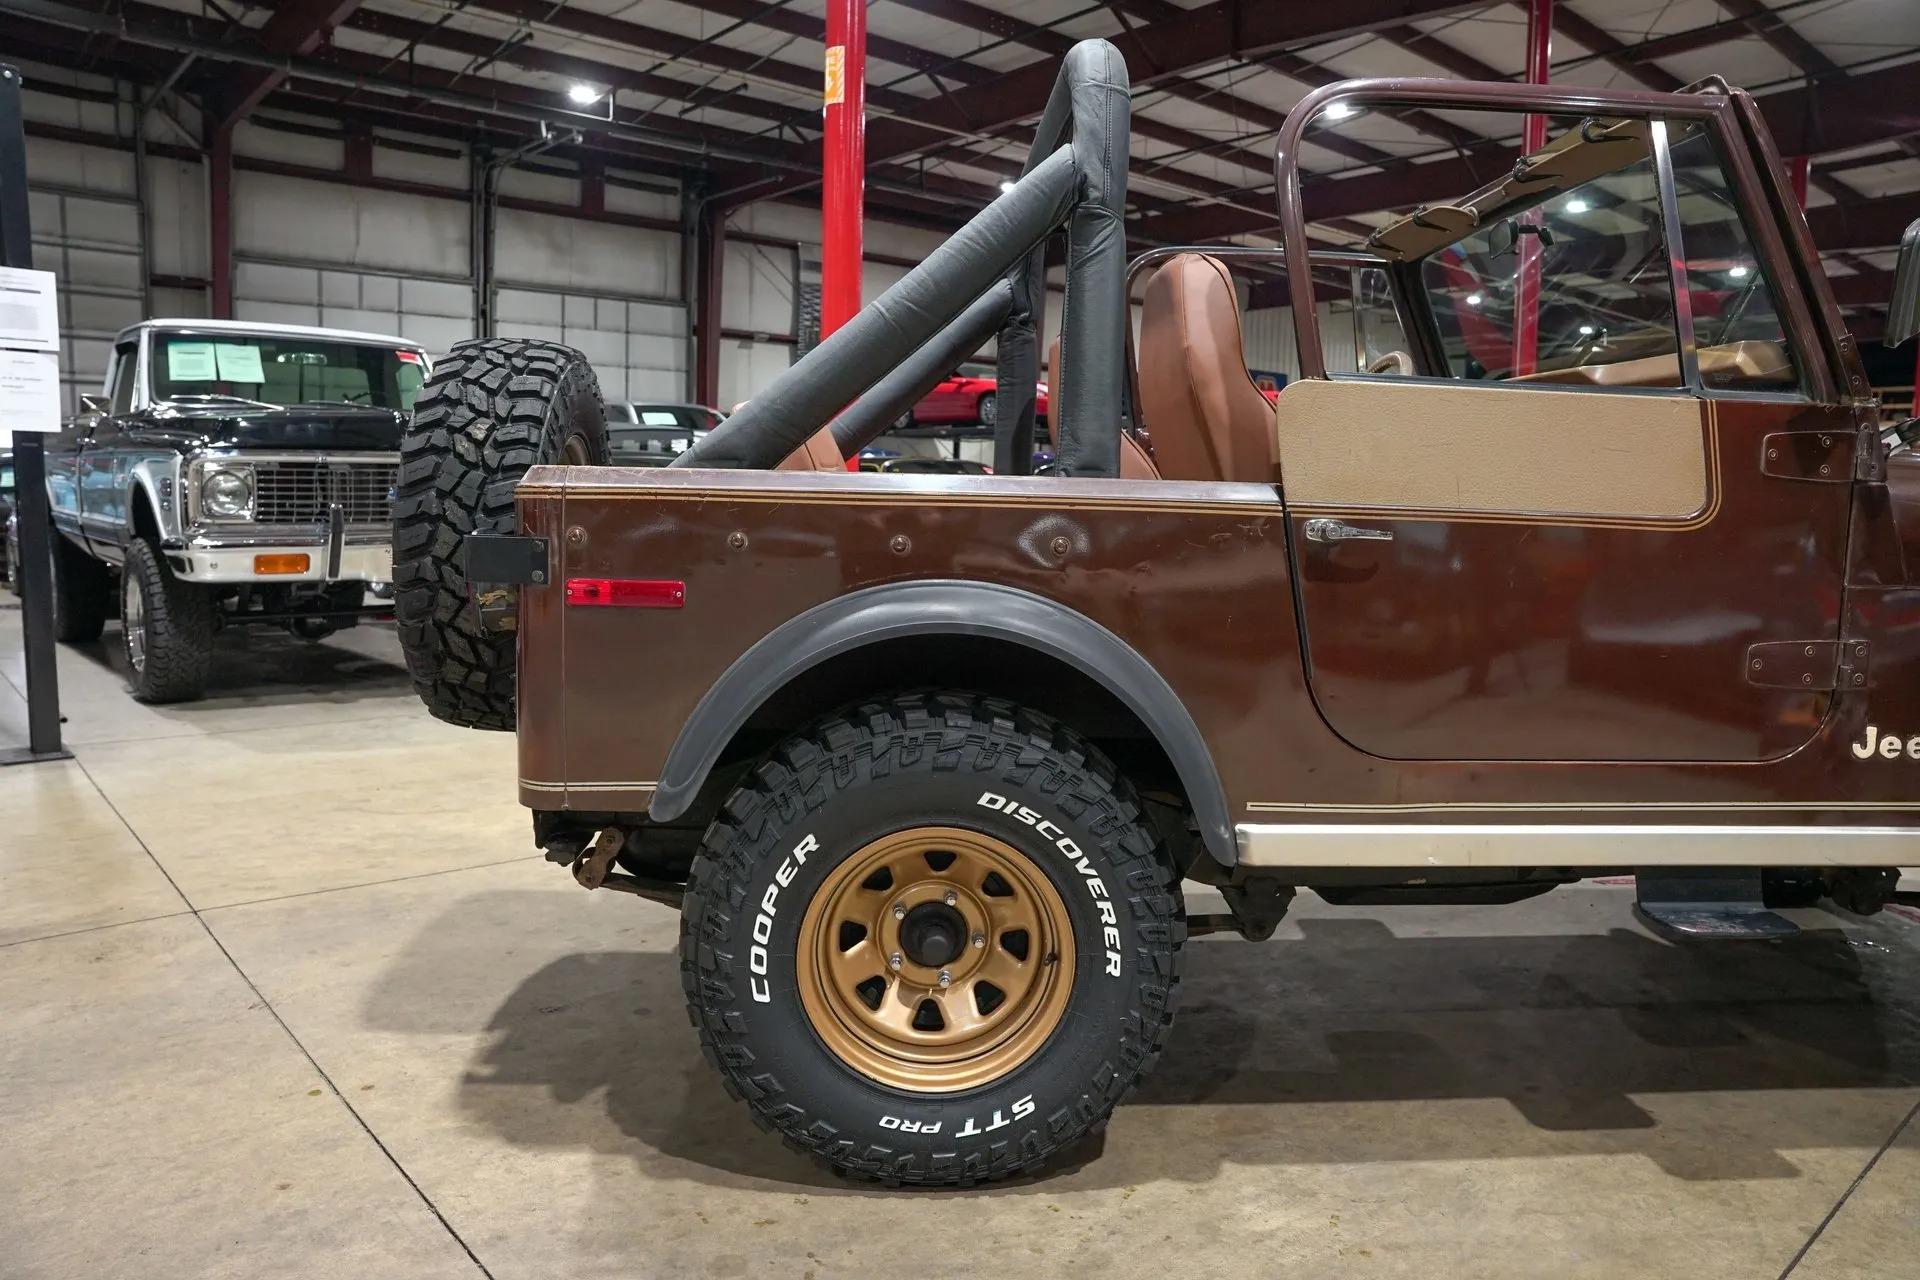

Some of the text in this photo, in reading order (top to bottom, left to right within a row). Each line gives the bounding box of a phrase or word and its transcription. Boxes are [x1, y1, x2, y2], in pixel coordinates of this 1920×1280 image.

[750, 833, 820, 1003] COOPER
[976, 791, 1122, 978] DISCOVERER
[878, 1093, 1037, 1139] STT PRO
